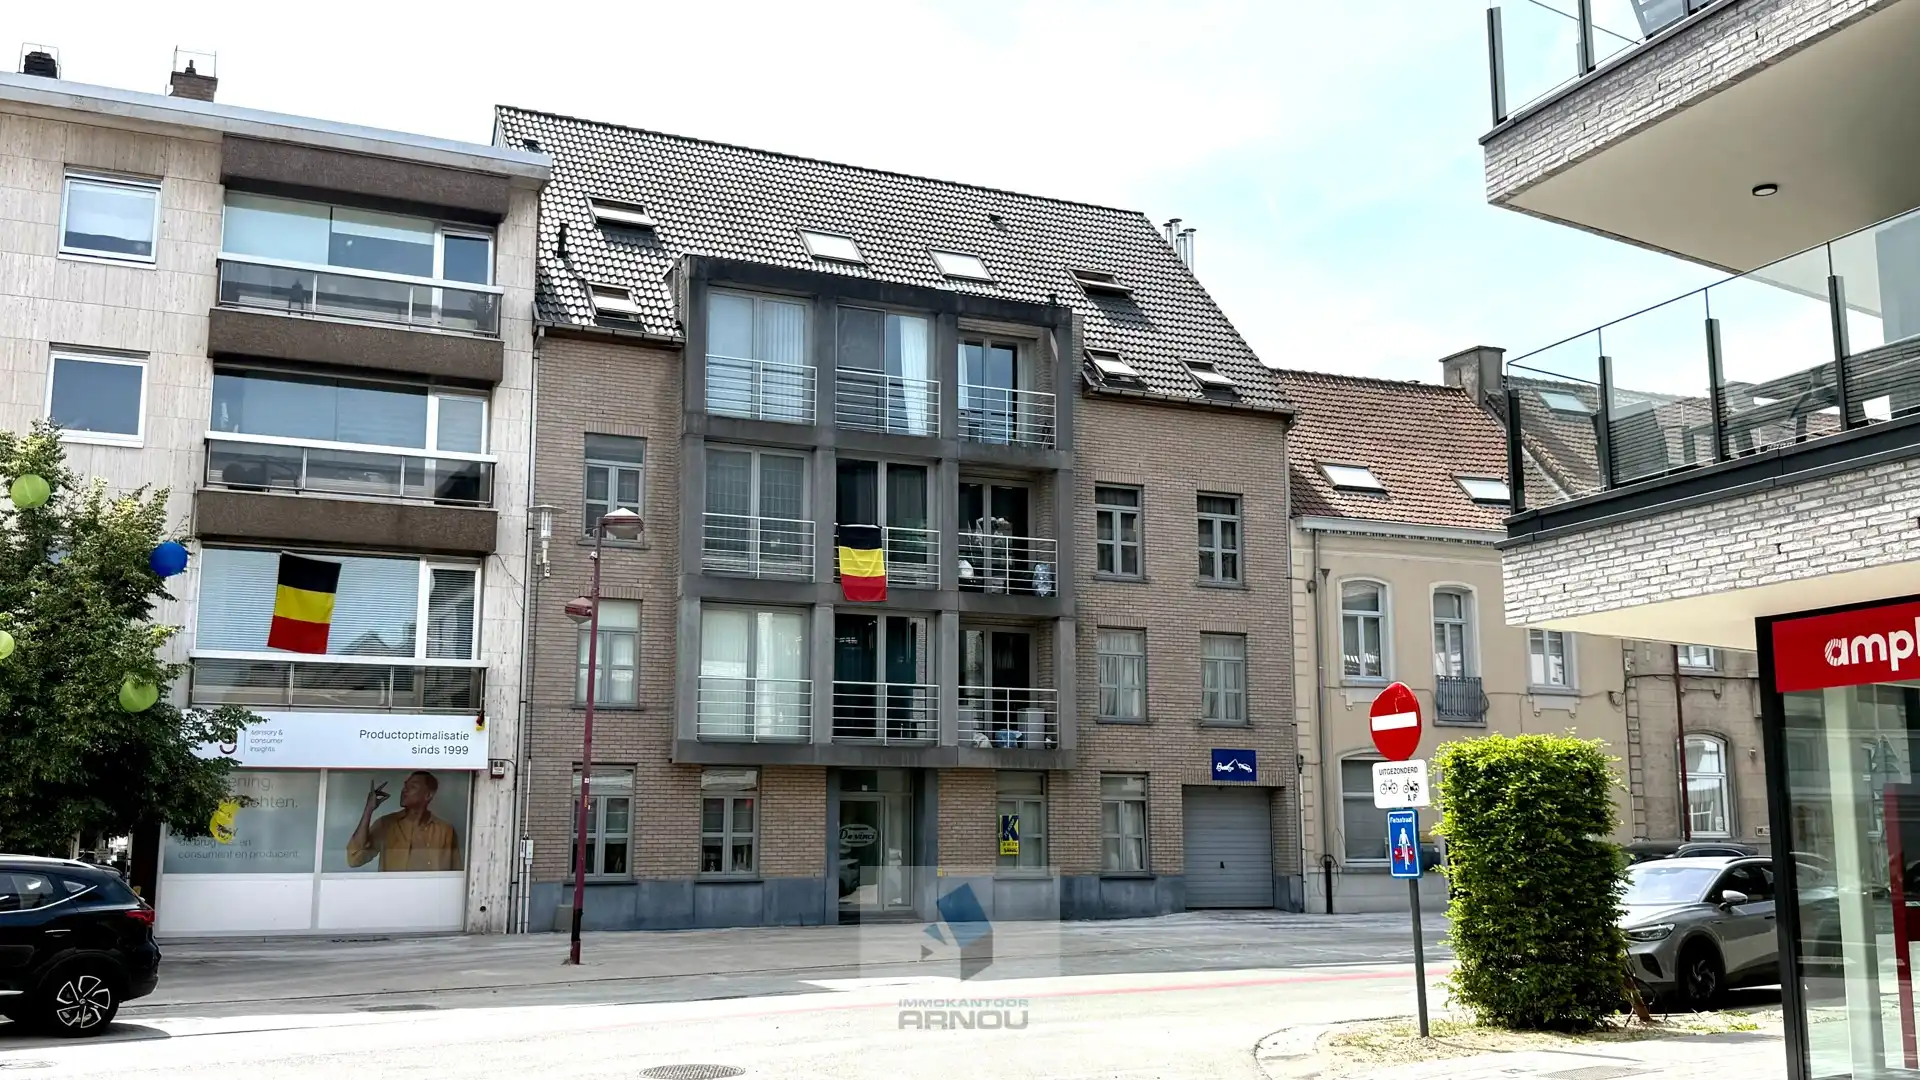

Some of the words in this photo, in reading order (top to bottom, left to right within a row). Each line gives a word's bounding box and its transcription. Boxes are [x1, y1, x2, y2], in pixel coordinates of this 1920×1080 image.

[359, 729, 470, 741] Productoptimalisatie
[250, 745, 276, 754] insights
[411, 744, 441, 755] sinds
[443, 745, 469, 755] 1999
[1378, 767, 1418, 775] UITGEZONDERD
[178, 851, 233, 860] consument
[234, 852, 248, 860] en
